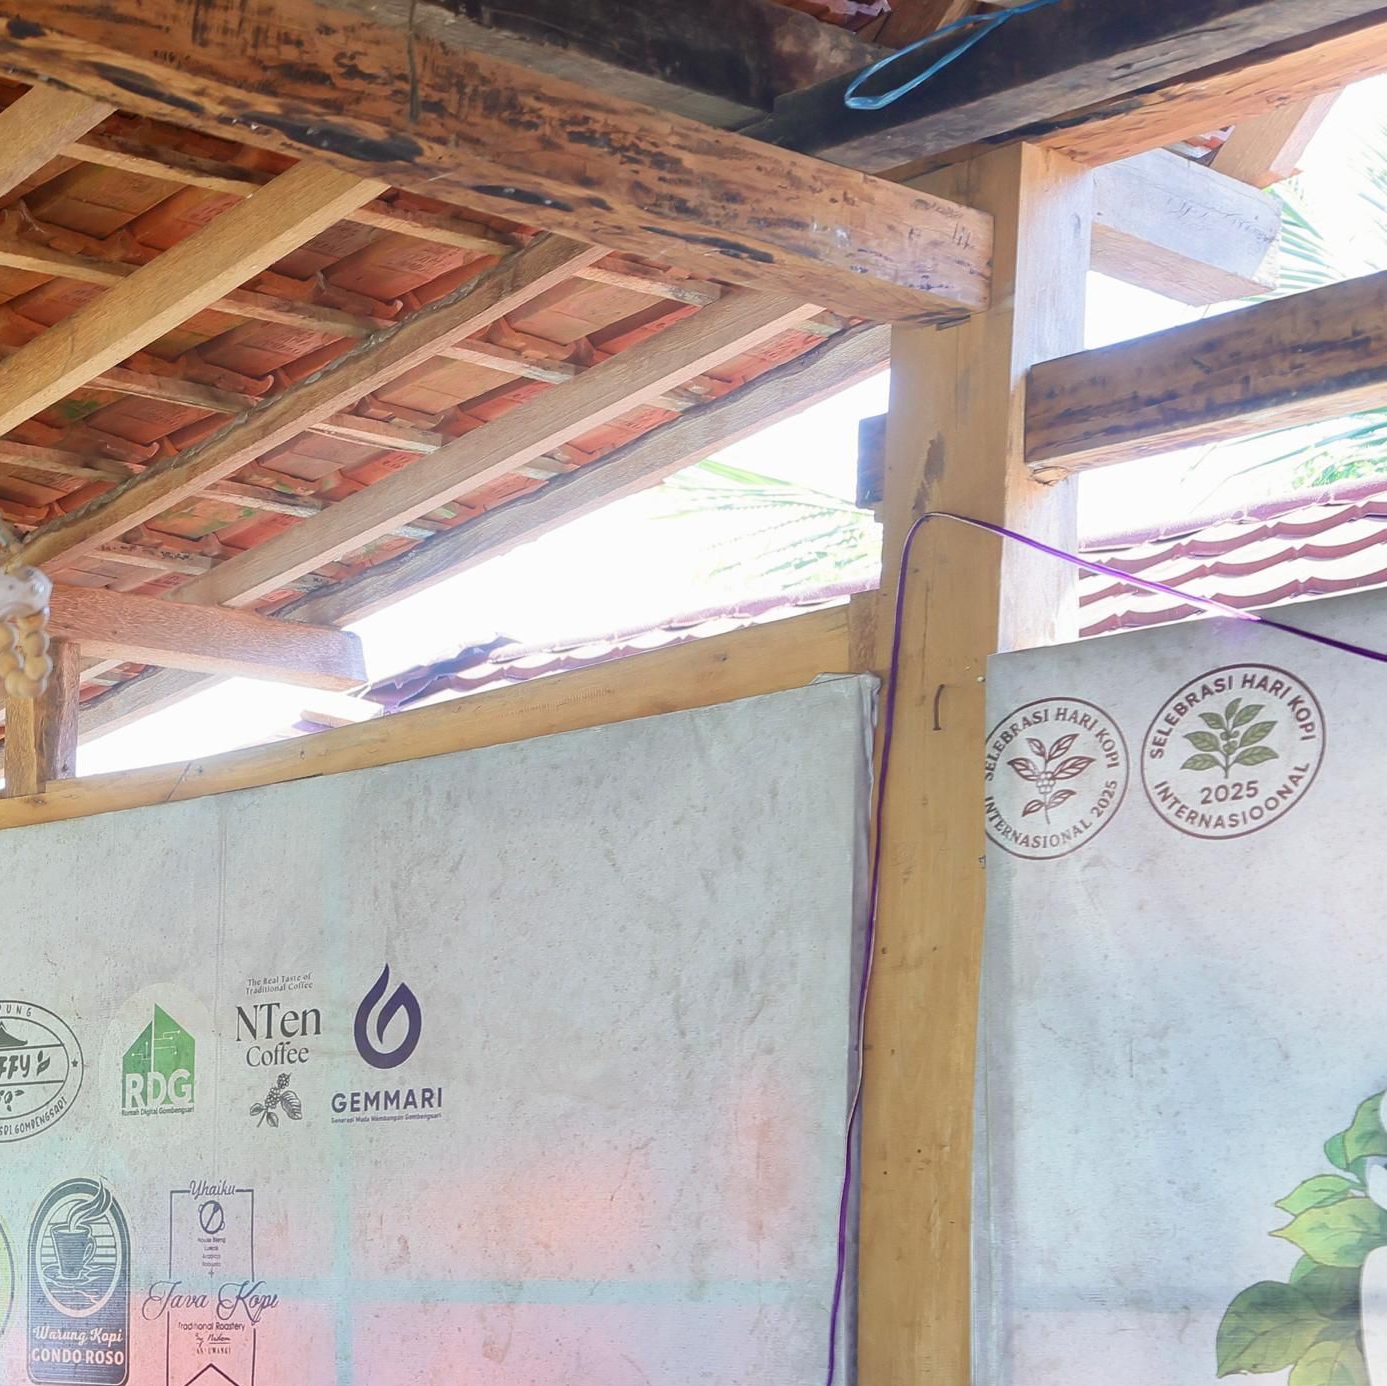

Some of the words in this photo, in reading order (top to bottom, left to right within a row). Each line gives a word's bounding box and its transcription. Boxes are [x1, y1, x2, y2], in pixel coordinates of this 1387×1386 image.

[1150, 675, 1233, 759] SELEBRASI
[1241, 673, 1292, 700] HARI
[1287, 695, 1316, 741] KOPI
[985, 708, 1050, 781] SELEBRASI
[1054, 707, 1099, 731] HARI
[1095, 728, 1120, 769] KOPI
[1091, 780, 1118, 818] 2025
[1154, 762, 1310, 829] INTERNASIOONAL
[1200, 780, 1259, 805] 2025
[246, 984, 286, 995] Traditional
[288, 981, 313, 991] Coffee
[248, 978, 261, 986] The
[263, 976, 279, 984] Real
[281, 975, 301, 983] Taste
[302, 972, 312, 980] of
[235, 1002, 321, 1041] NTen
[246, 1041, 309, 1067] Coffee
[126, 1068, 192, 1109] RDG
[331, 1087, 442, 1113] GEMMARI
[142, 1280, 209, 1321] Java
[216, 1280, 279, 1326] Kopi
[32, 1325, 88, 1346] Warung
[90, 1327, 123, 1348] Kopi
[215, 1321, 246, 1332] Roastery
[31, 1348, 82, 1364] GONDO
[85, 1350, 124, 1365] ROSO
